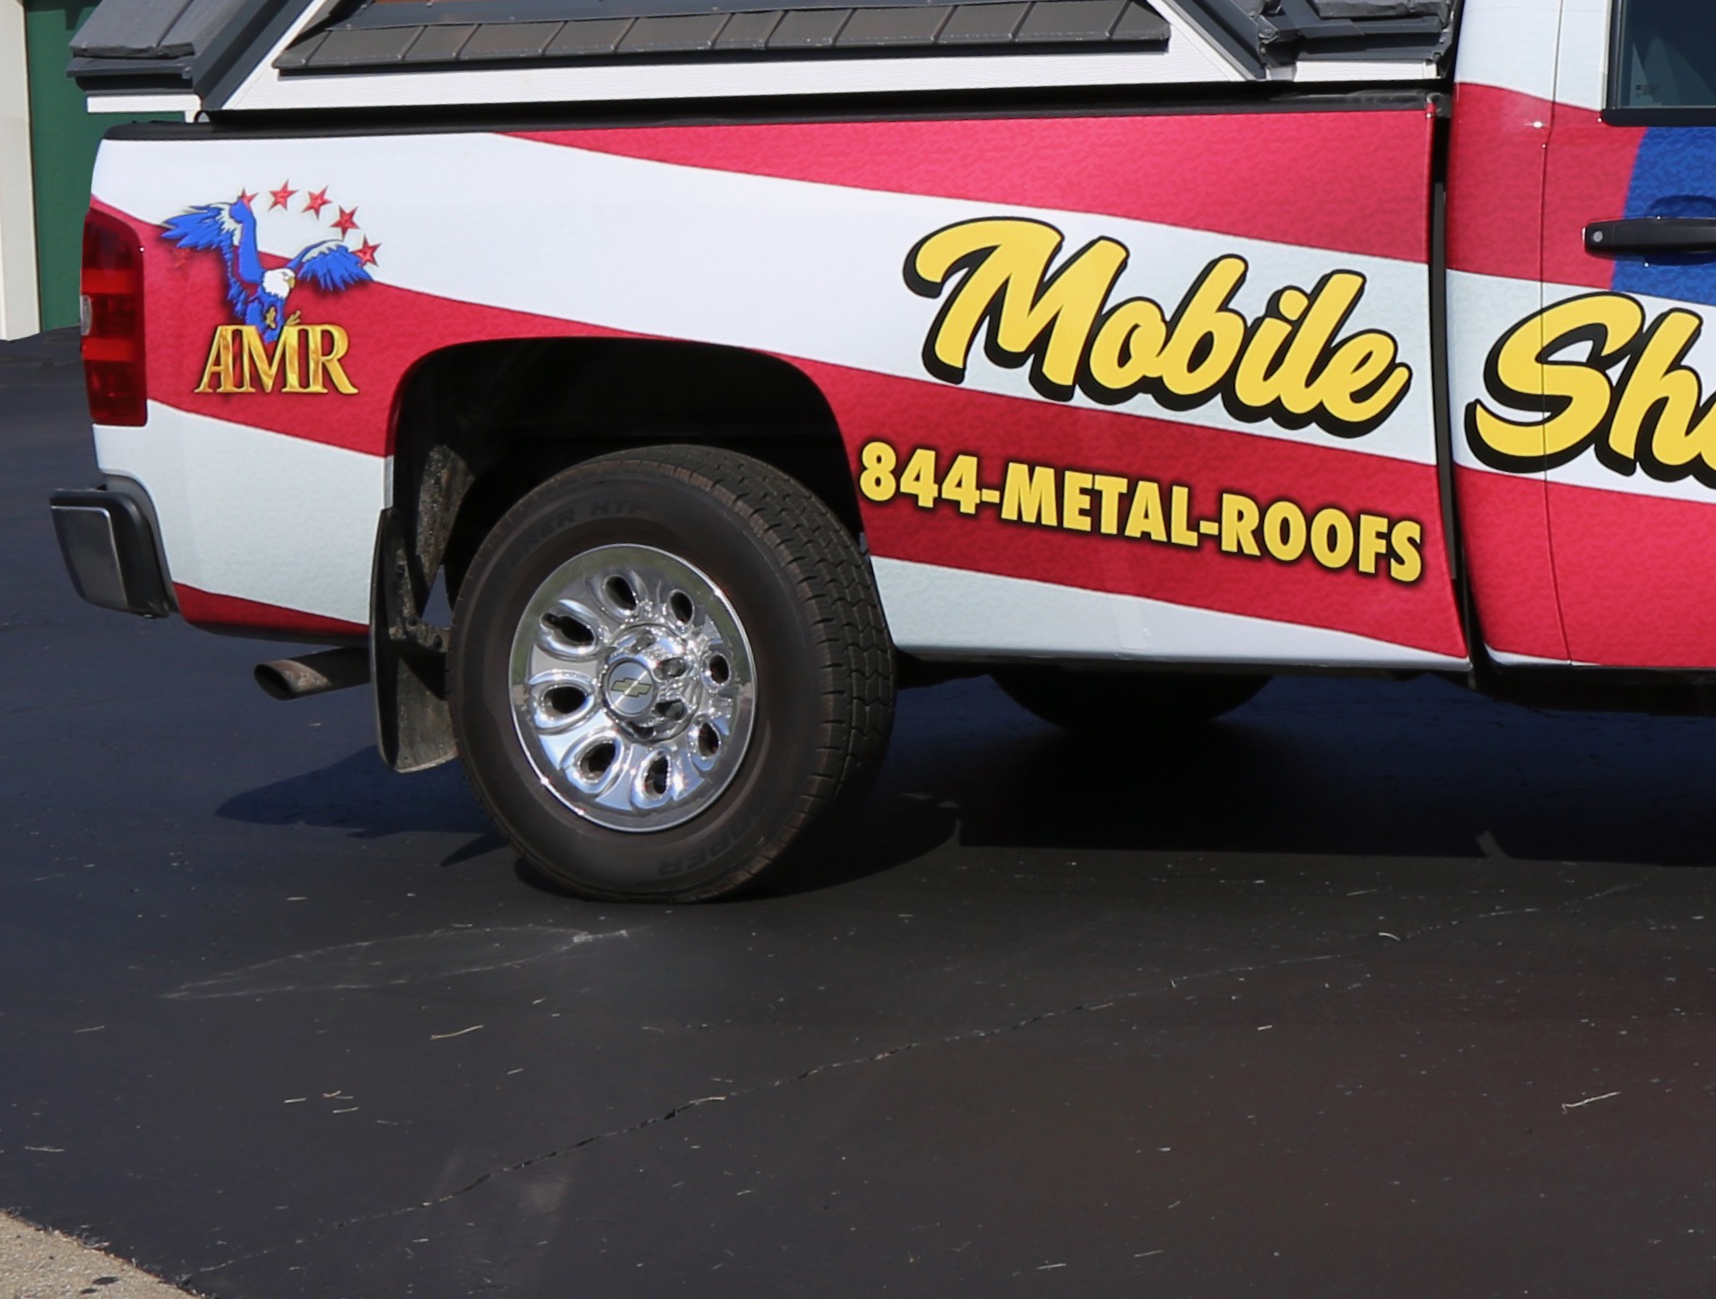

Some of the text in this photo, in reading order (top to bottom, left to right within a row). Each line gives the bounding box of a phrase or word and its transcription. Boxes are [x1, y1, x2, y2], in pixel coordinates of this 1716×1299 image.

[194, 323, 360, 395] AMR
[903, 215, 1413, 439] Mobile
[858, 440, 1423, 585] 844-METAL-ROOFS
